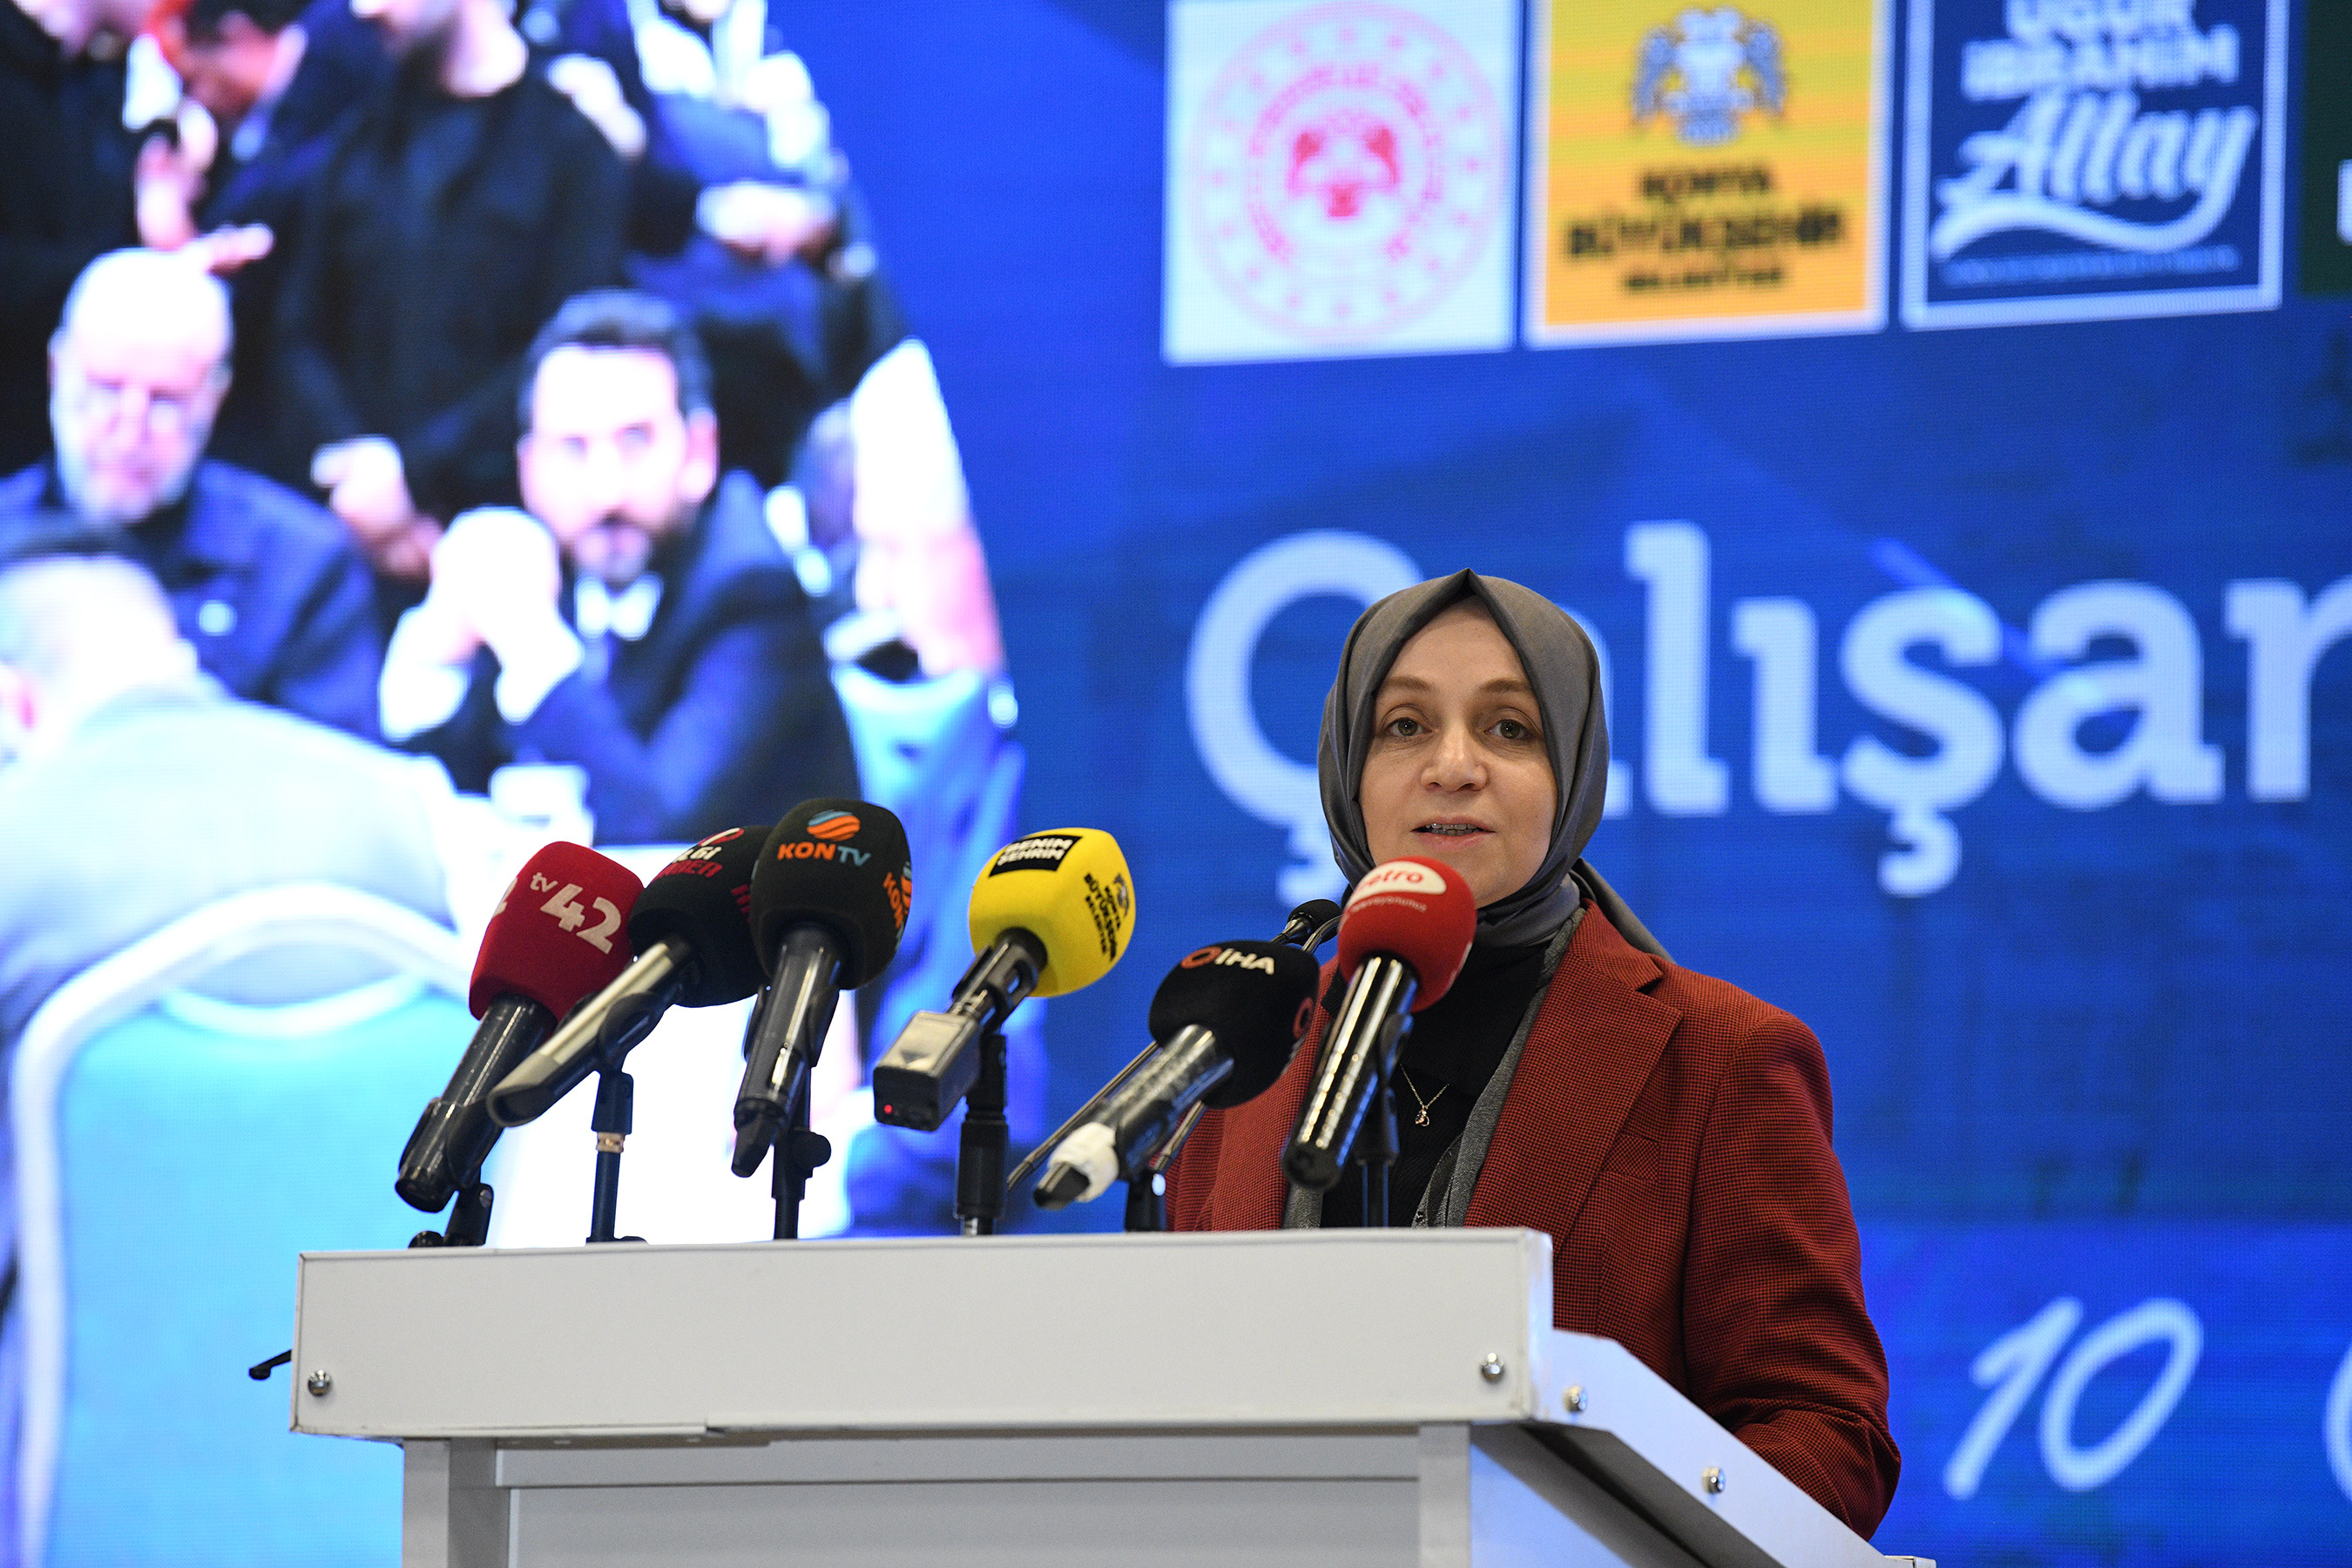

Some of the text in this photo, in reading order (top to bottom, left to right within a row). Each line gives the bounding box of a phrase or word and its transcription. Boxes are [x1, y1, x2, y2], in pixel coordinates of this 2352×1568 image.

[1185, 519, 2352, 908] Çlışa
[530, 872, 558, 893] tv
[539, 882, 622, 955] 42
[1942, 1295, 2205, 1502] 10
